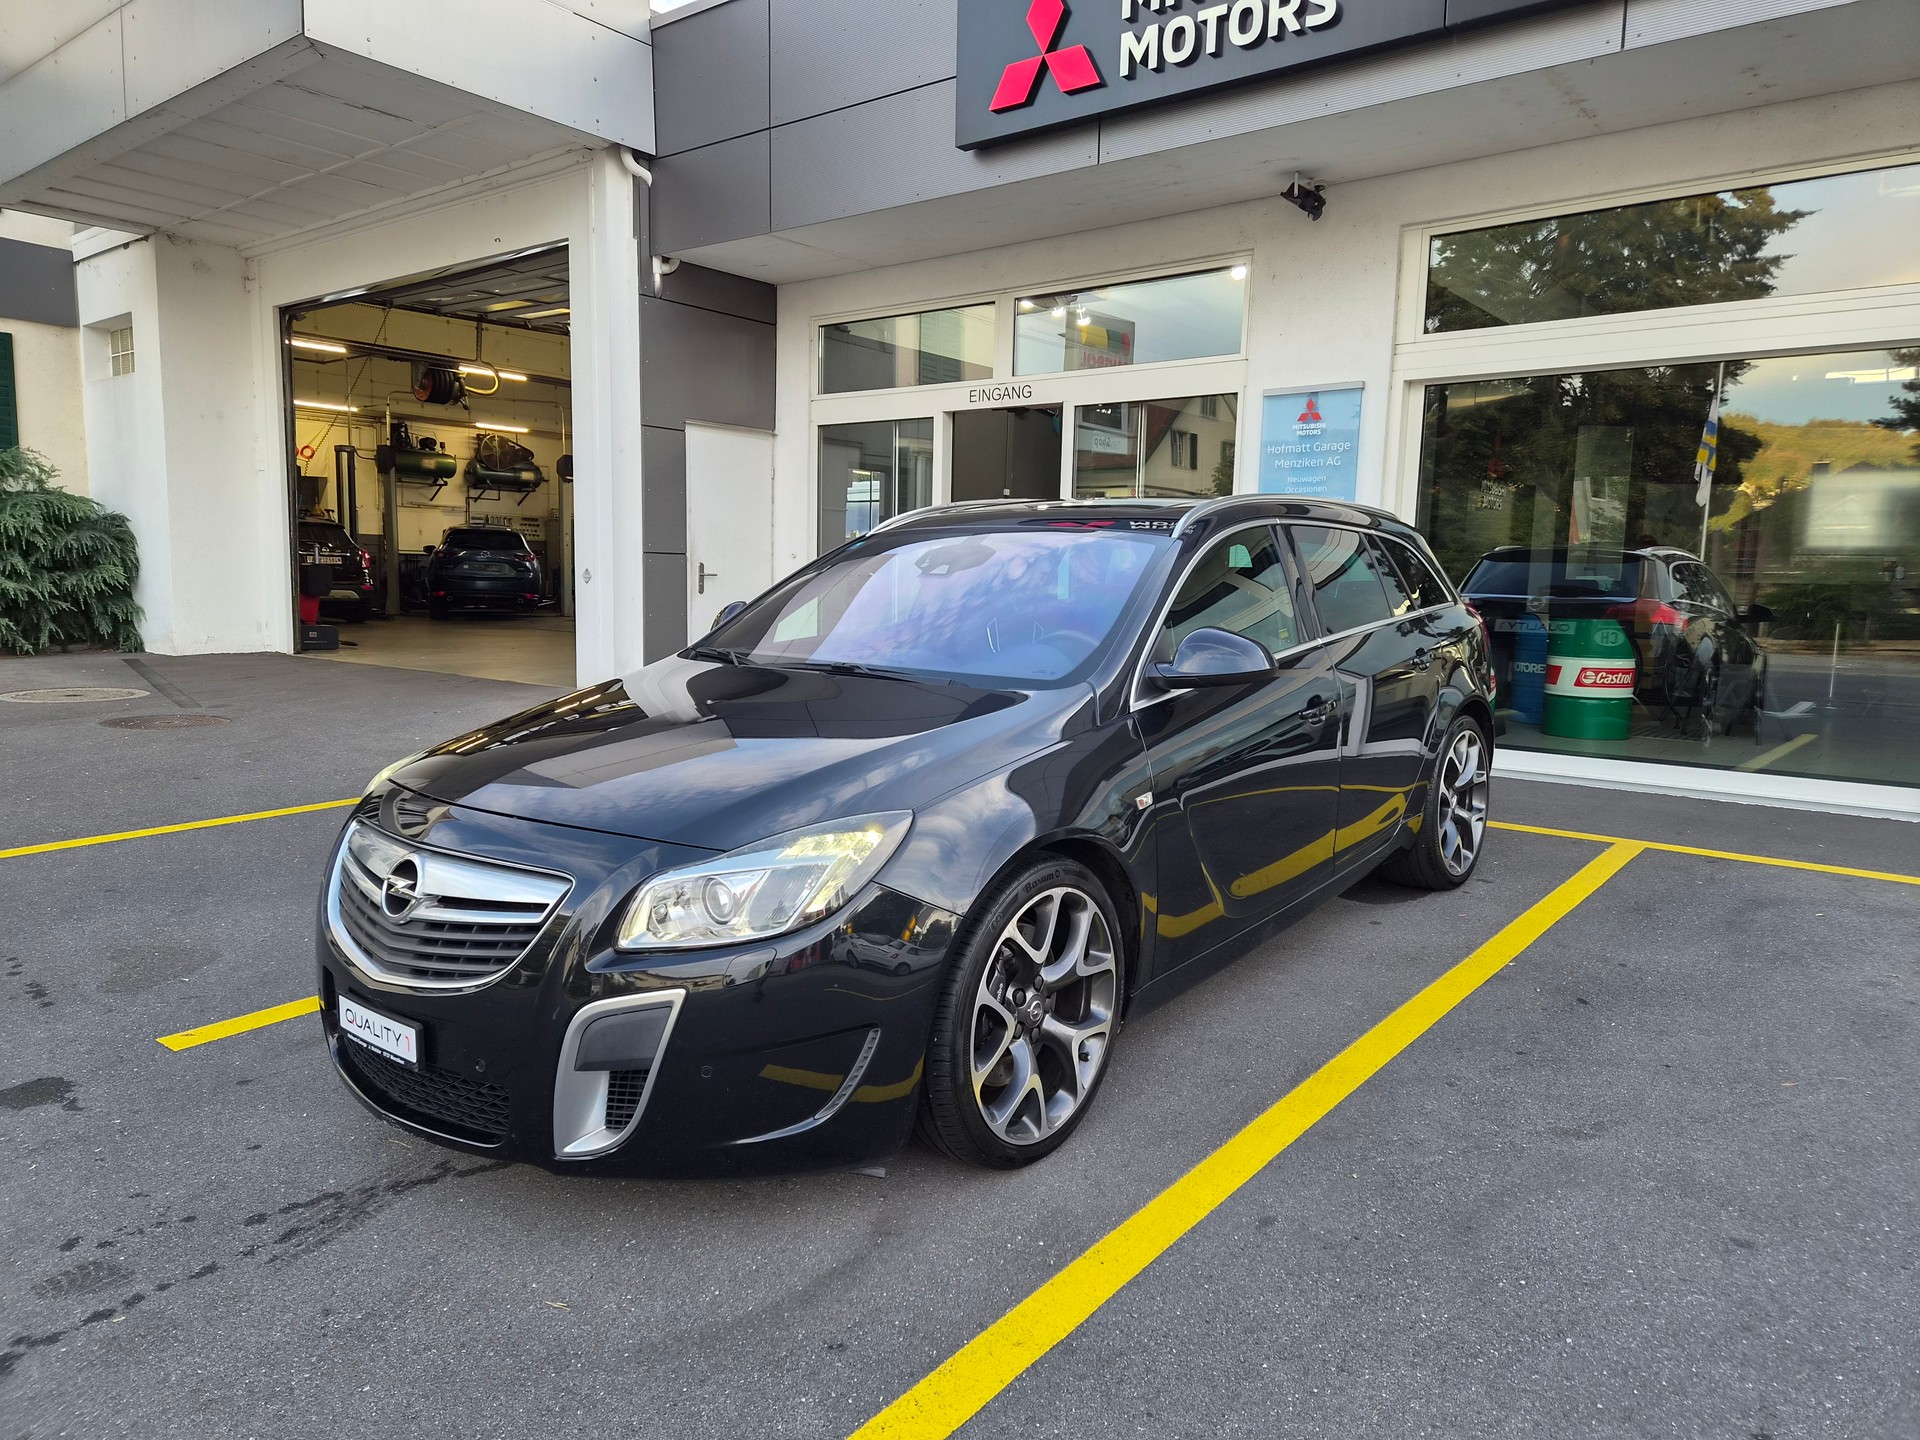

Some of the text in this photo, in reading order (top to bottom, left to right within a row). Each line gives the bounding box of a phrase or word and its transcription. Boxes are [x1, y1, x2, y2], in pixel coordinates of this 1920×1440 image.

[1119, 0, 1337, 77] MOTORS
[969, 384, 1032, 402] EINGANG
[1267, 441, 1351, 454] Hofmatt Garage
[1274, 456, 1341, 468] Menziken AG
[1287, 475, 1327, 484] Neuwagen
[1285, 486, 1328, 494] Occasionen
[1595, 672, 1632, 685] Castrol
[345, 1008, 402, 1047] QUALITY
[405, 1035, 411, 1052] 1
